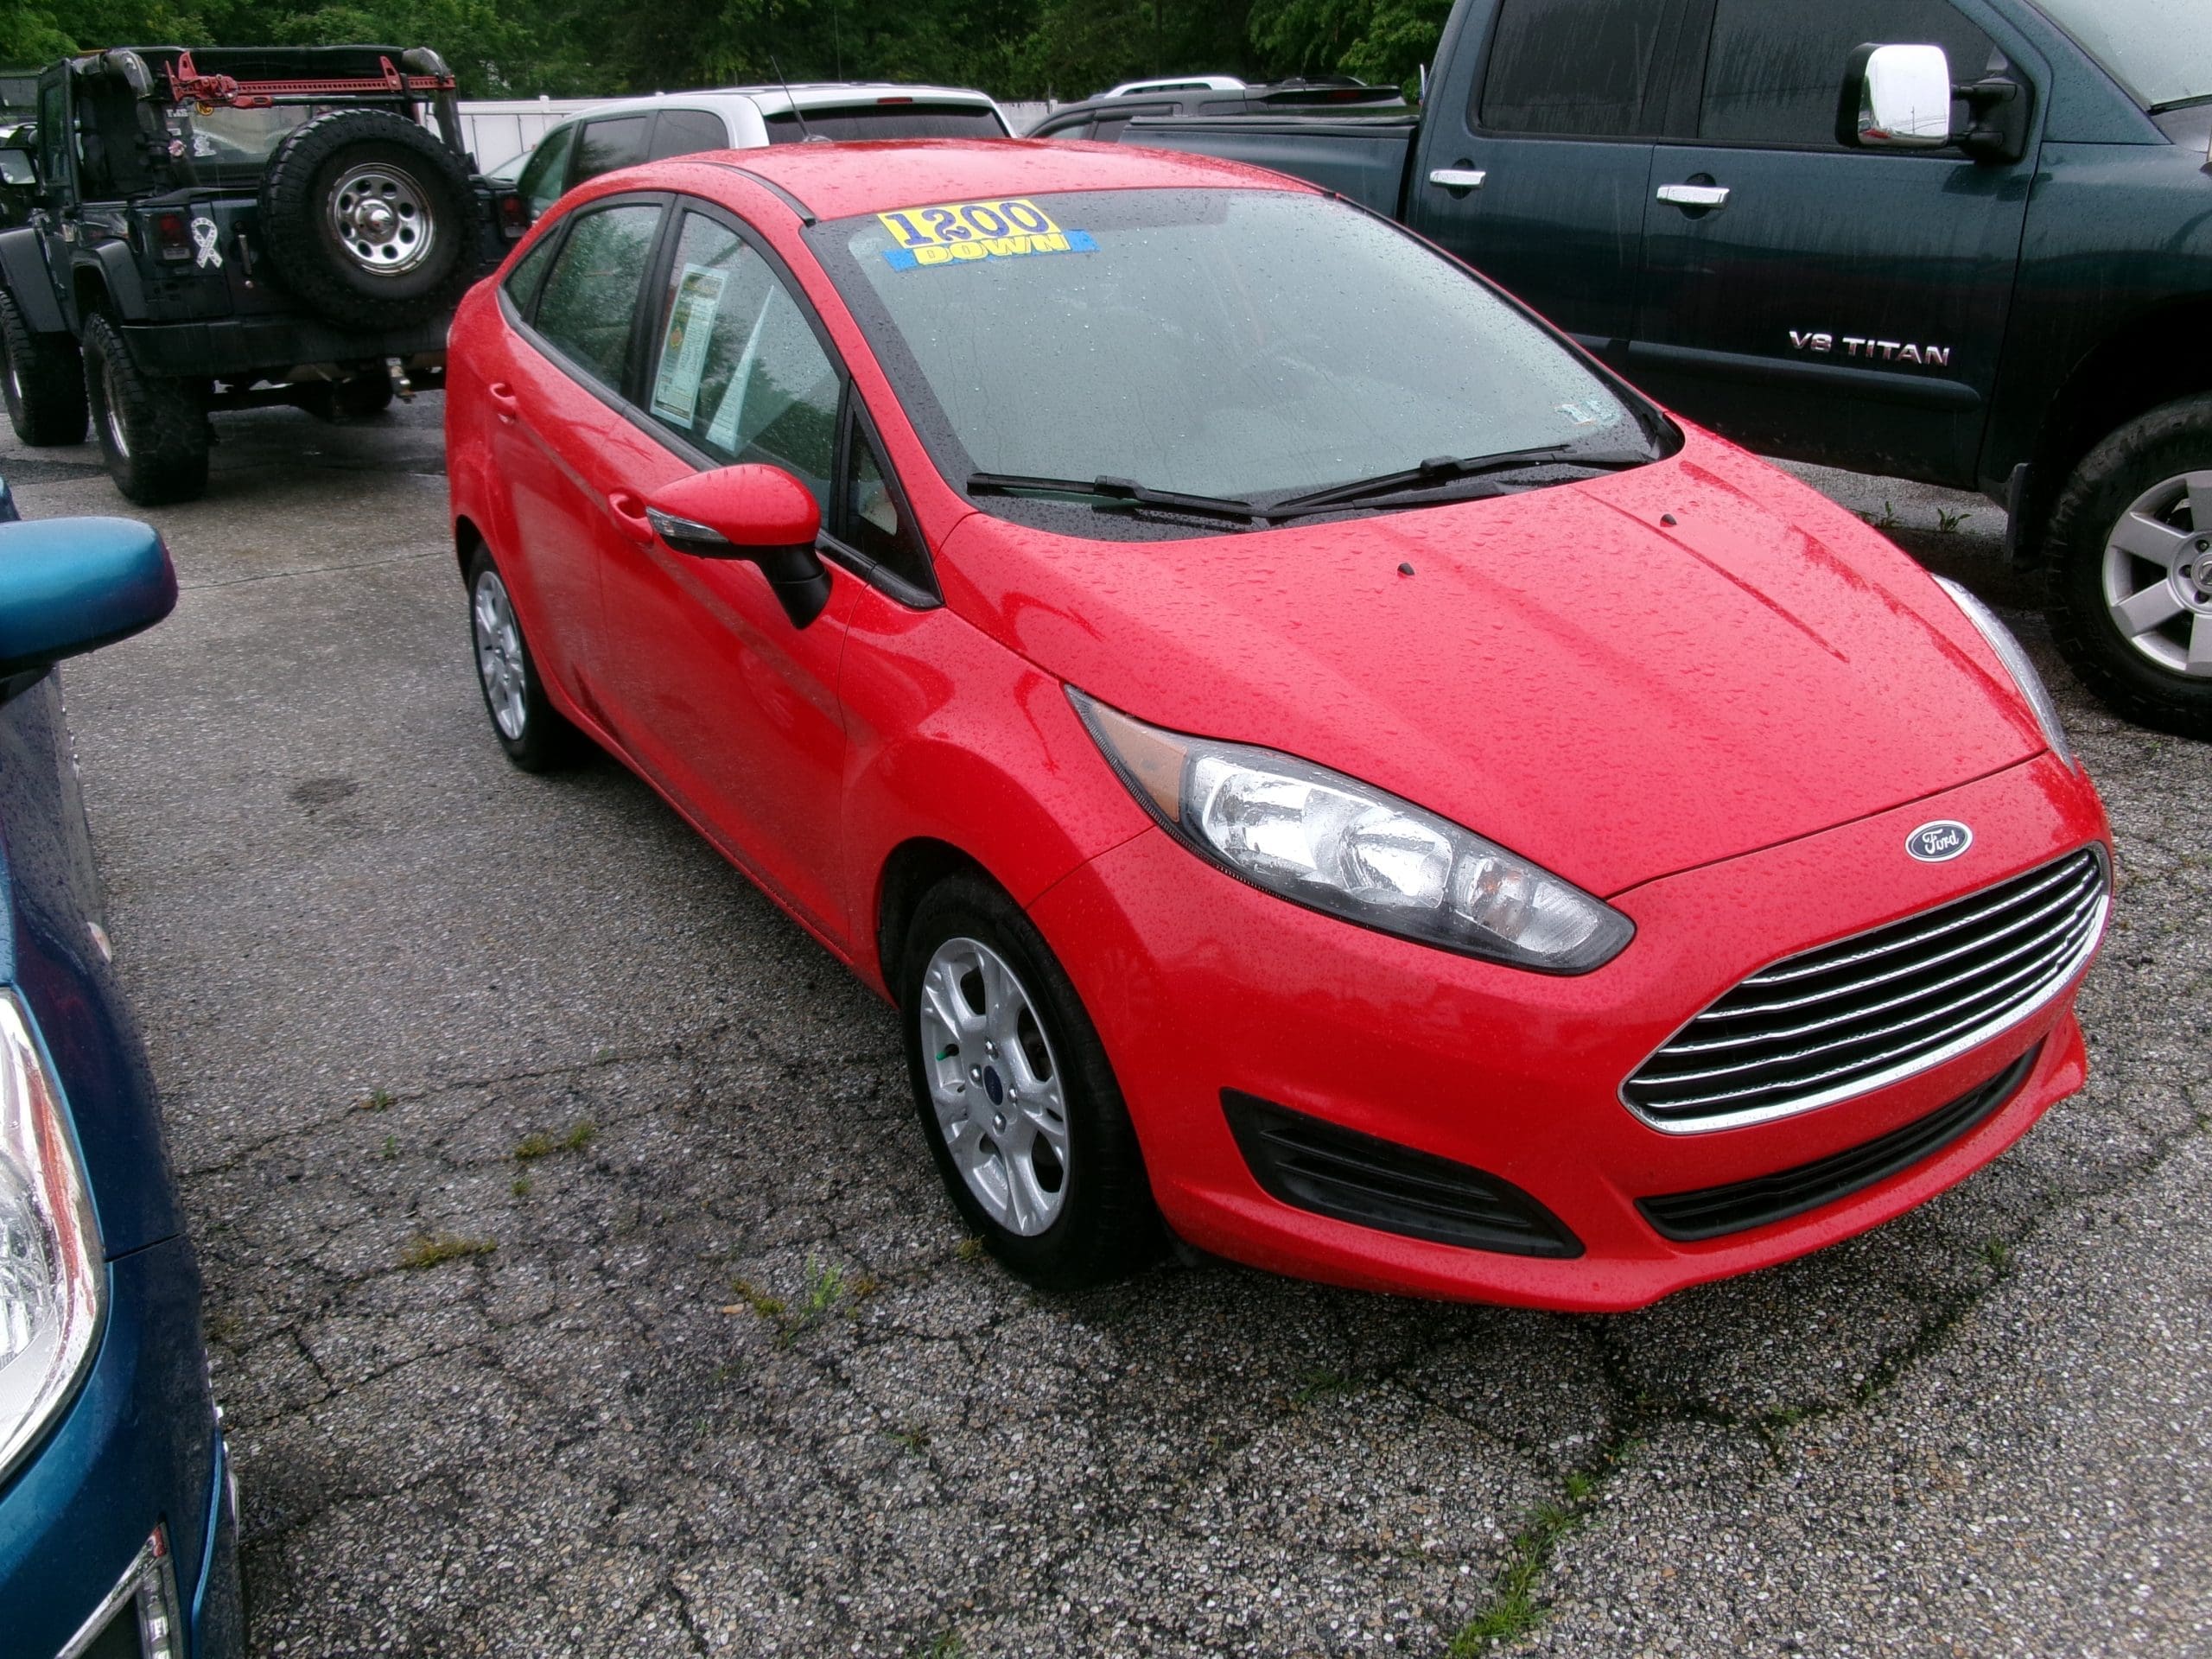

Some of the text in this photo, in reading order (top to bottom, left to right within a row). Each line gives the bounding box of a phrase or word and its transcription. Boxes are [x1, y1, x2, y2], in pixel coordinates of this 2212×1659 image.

[885, 201, 1049, 246] 1200
[912, 233, 1071, 265] DOWN
[1789, 330, 1950, 367] V8 TITAN
[1922, 828, 1960, 855] Ford
